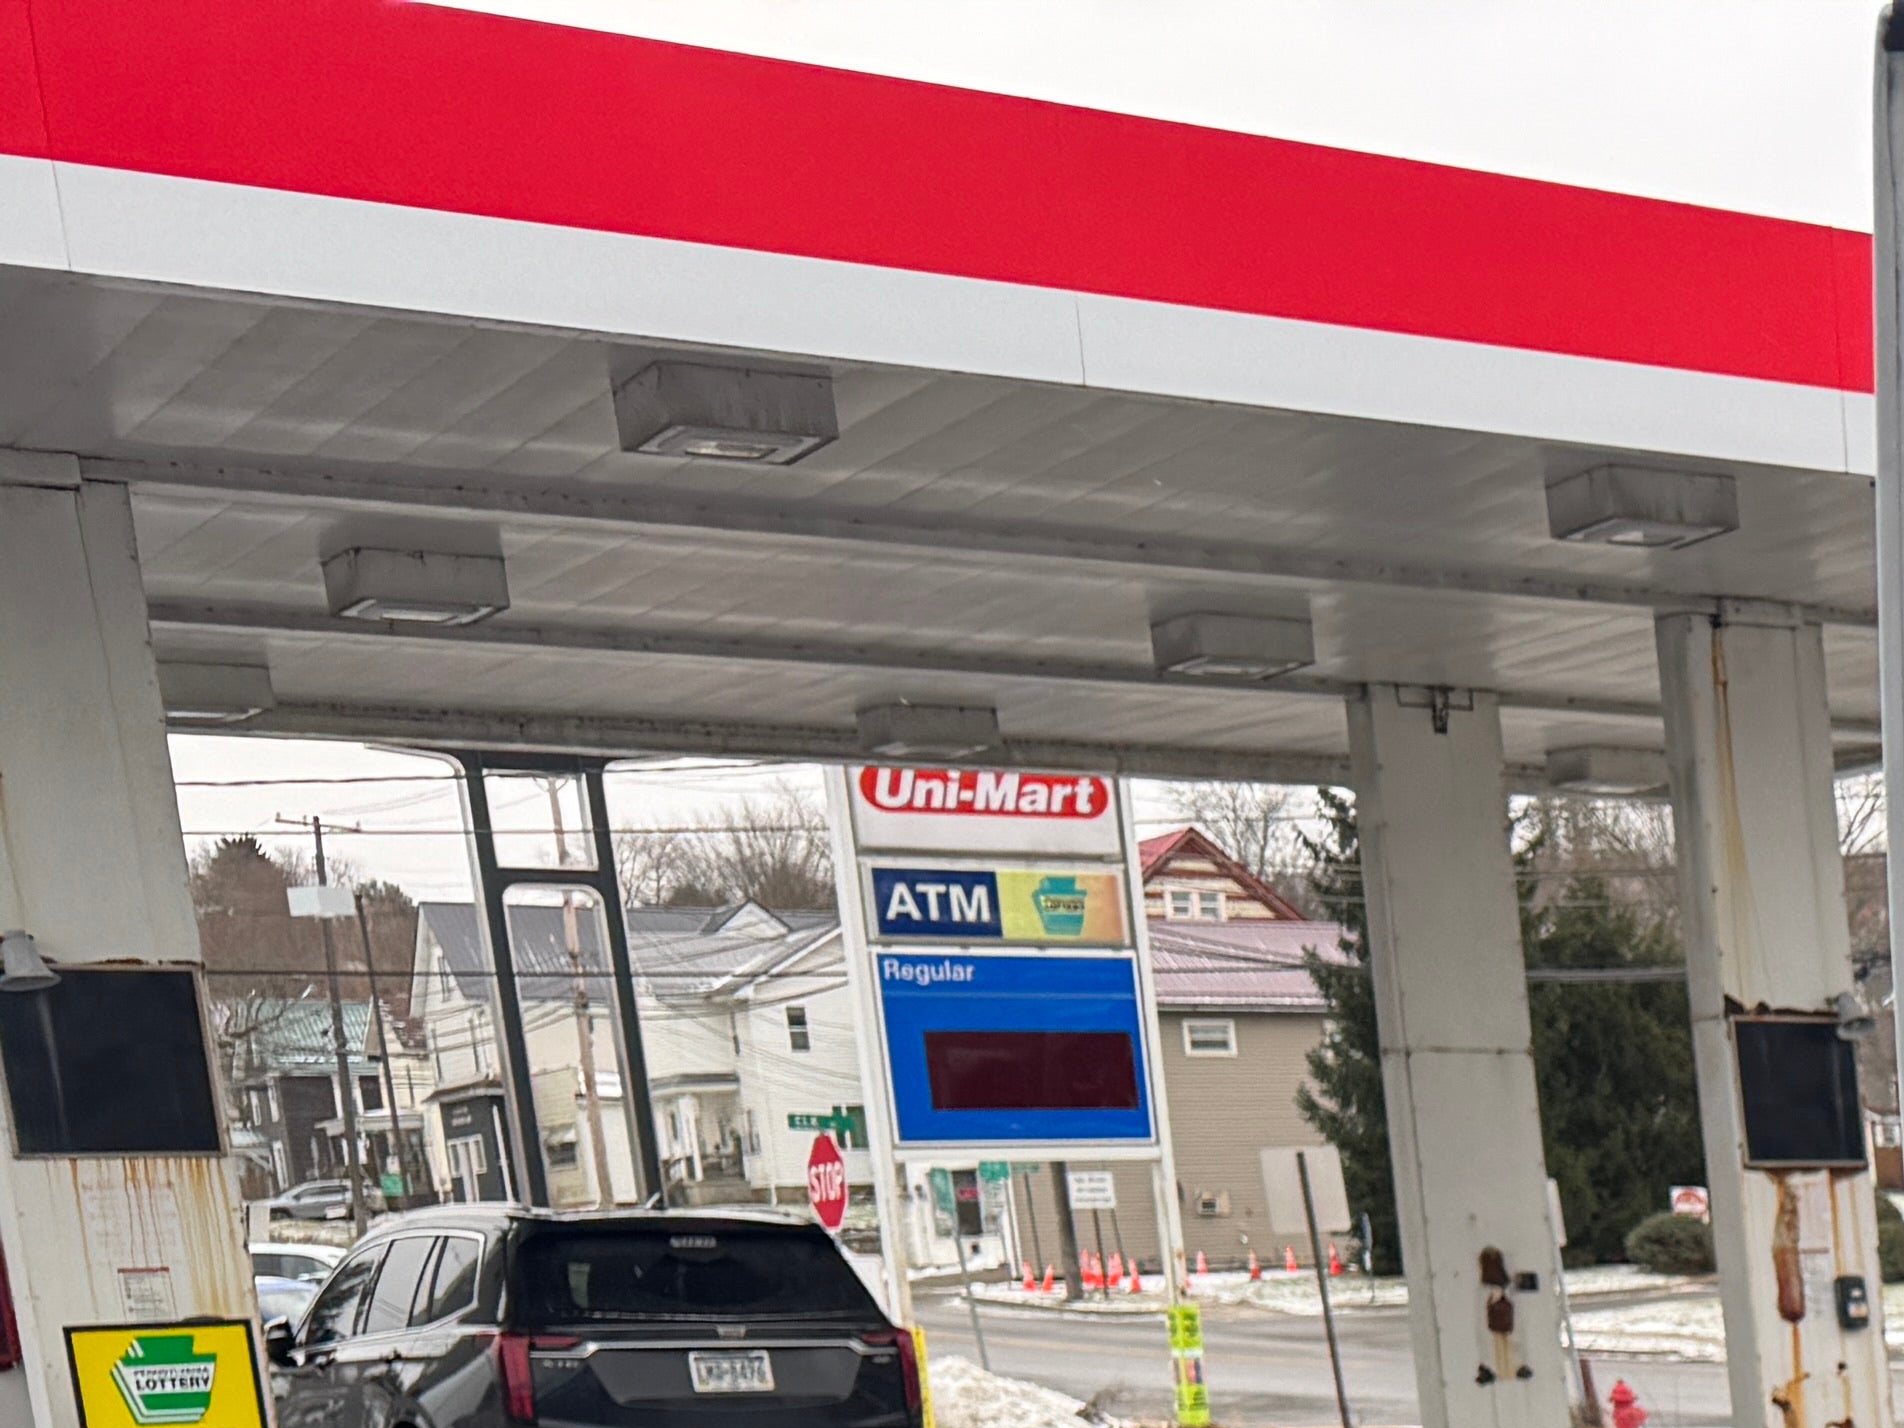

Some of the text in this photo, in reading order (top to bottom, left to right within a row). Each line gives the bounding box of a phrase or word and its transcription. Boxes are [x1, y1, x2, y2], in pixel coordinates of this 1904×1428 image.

[875, 768, 1094, 814] Uni-Mart
[886, 882, 991, 922] ATM
[884, 959, 974, 985] Regular
[810, 1161, 843, 1203] STOP
[135, 1375, 210, 1391] LOTTERY
